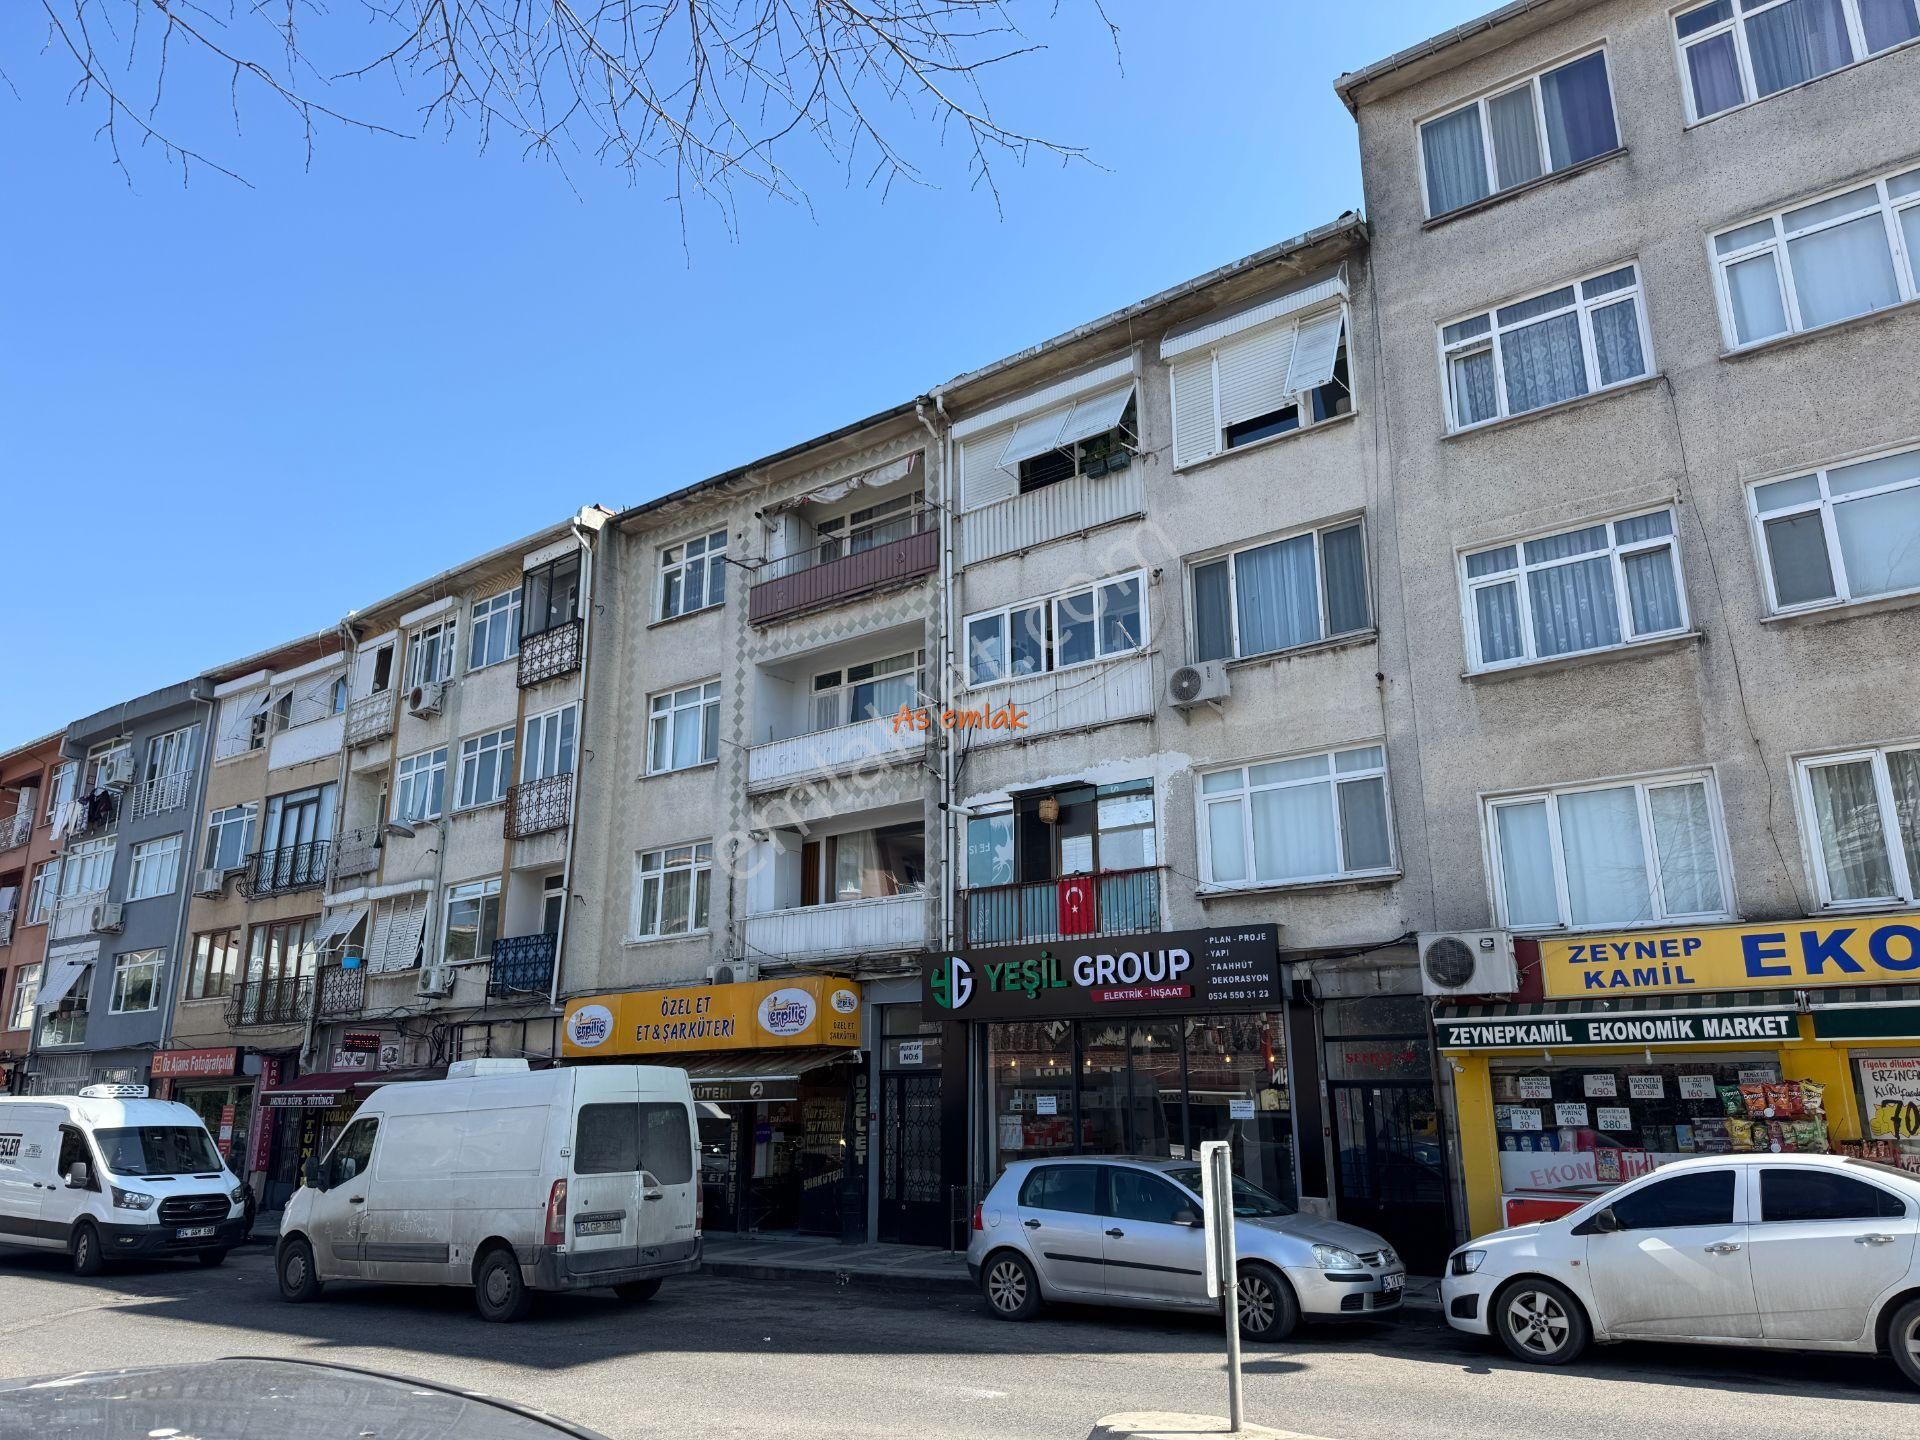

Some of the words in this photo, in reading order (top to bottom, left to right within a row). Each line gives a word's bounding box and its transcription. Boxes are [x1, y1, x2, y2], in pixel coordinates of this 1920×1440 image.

[1209, 935, 1231, 944] PLAN
[1238, 933, 1267, 942] PROJE
[1210, 950, 1229, 958] YAPI
[1568, 937, 1702, 963] ZEYNEP
[1741, 923, 1920, 977] EKO
[984, 951, 1067, 1000] YEŞİL
[1073, 946, 1190, 987] GROUP
[1211, 960, 1253, 971] TAAHHÜT
[1211, 974, 1269, 985] DEKORASYON
[1584, 962, 1695, 990] KAMİL
[1104, 987, 1143, 1001] ELEKTRİK
[1150, 987, 1183, 999] İNŞAAT
[1208, 992, 1228, 1000] 0534
[1229, 991, 1244, 999] 550
[1246, 990, 1257, 998] 31
[661, 996, 692, 1017] ÖZEL
[696, 996, 711, 1014] ET
[768, 1002, 807, 1028] erpiliç
[575, 1018, 606, 1040] erpiliç
[833, 1020, 847, 1030] ÖZEL
[847, 1021, 856, 1030] ET
[1449, 1020, 1573, 1045] ZEYNEPKAMİL
[1588, 1015, 1694, 1041] EKONOMİK
[1702, 1014, 1789, 1037] MARKET
[171, 1056, 189, 1075] Ajans
[1890, 1059, 1916, 1069] dikkat
[753, 1084, 760, 1097] 2
[1592, 1087, 1609, 1095] 490
[1874, 1082, 1900, 1098] KURU
[1603, 1120, 1621, 1129] 380
[1881, 1099, 1920, 1140] 70
